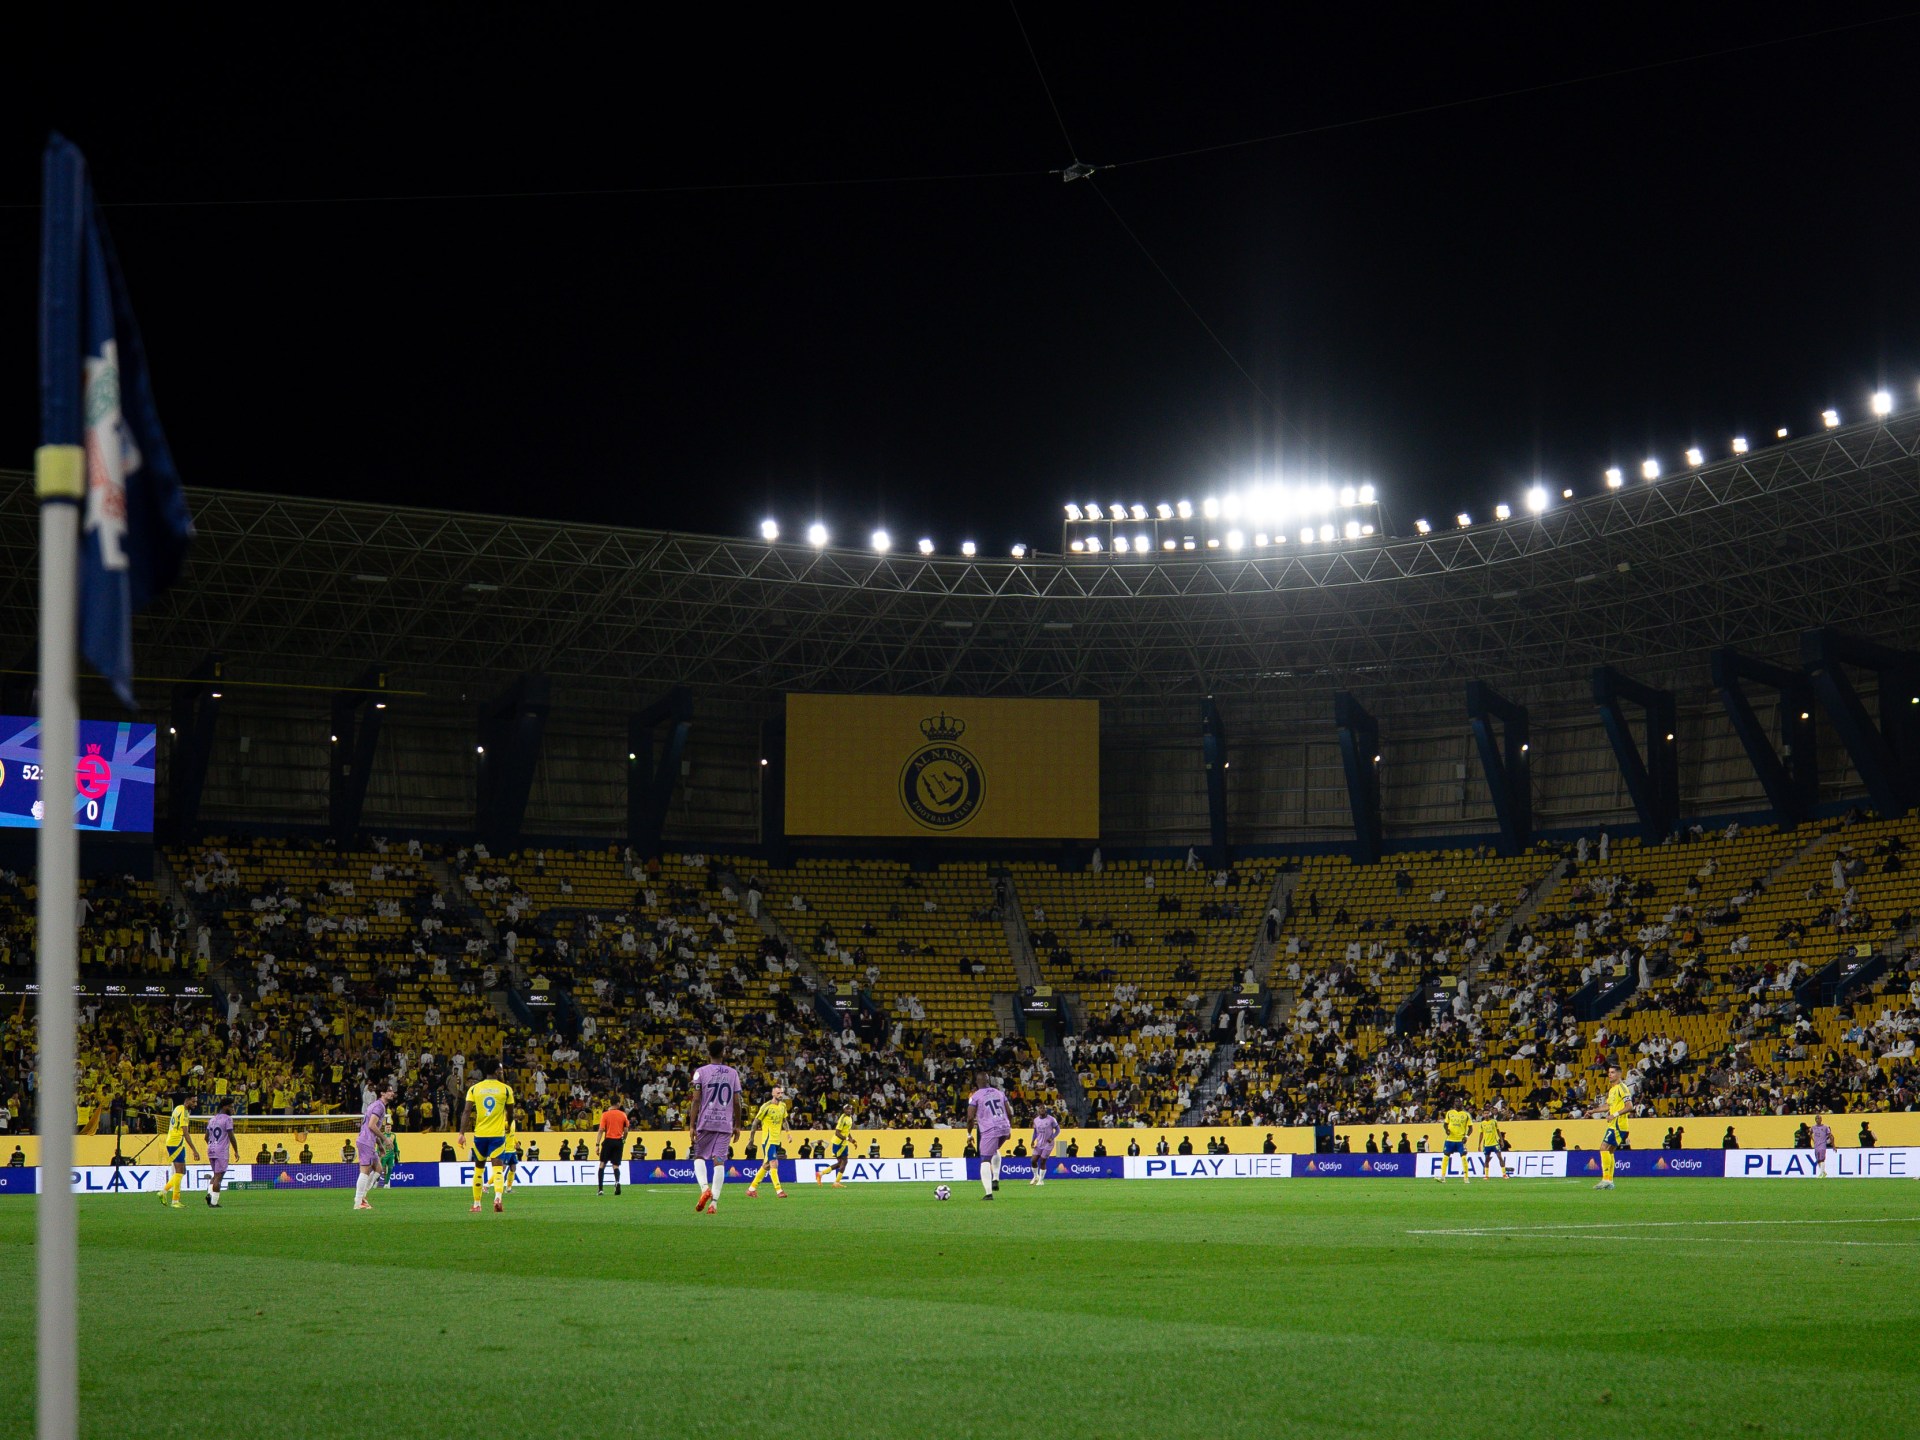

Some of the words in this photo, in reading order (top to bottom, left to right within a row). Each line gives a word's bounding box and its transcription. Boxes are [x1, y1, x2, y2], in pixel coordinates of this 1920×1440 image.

[914, 755, 931, 772] AL
[931, 749, 972, 772] NASSR
[87, 800, 99, 820] 0
[912, 800, 953, 823] FOOTBALL
[707, 1082, 732, 1106] 70
[483, 1096, 497, 1117] 9
[984, 1099, 1004, 1118] 15
[1604, 1130, 1612, 1142] 7
[898, 1162, 954, 1180] LIFE
[1002, 1165, 1031, 1175] Qiddiya
[1071, 1164, 1101, 1175] Qiddiya
[1147, 1159, 1224, 1176] PLAY
[1235, 1158, 1281, 1176] LIFE
[1319, 1161, 1342, 1171] Qiddiya
[1374, 1161, 1399, 1171] Qiddiya
[1615, 1159, 1631, 1171] diya
[1671, 1159, 1702, 1170] Qiddiya
[1745, 1154, 1818, 1175] PLAY
[1839, 1153, 1906, 1175] LIFE
[296, 1172, 332, 1183] Qiddiya
[668, 1168, 695, 1178] Qiddiy
